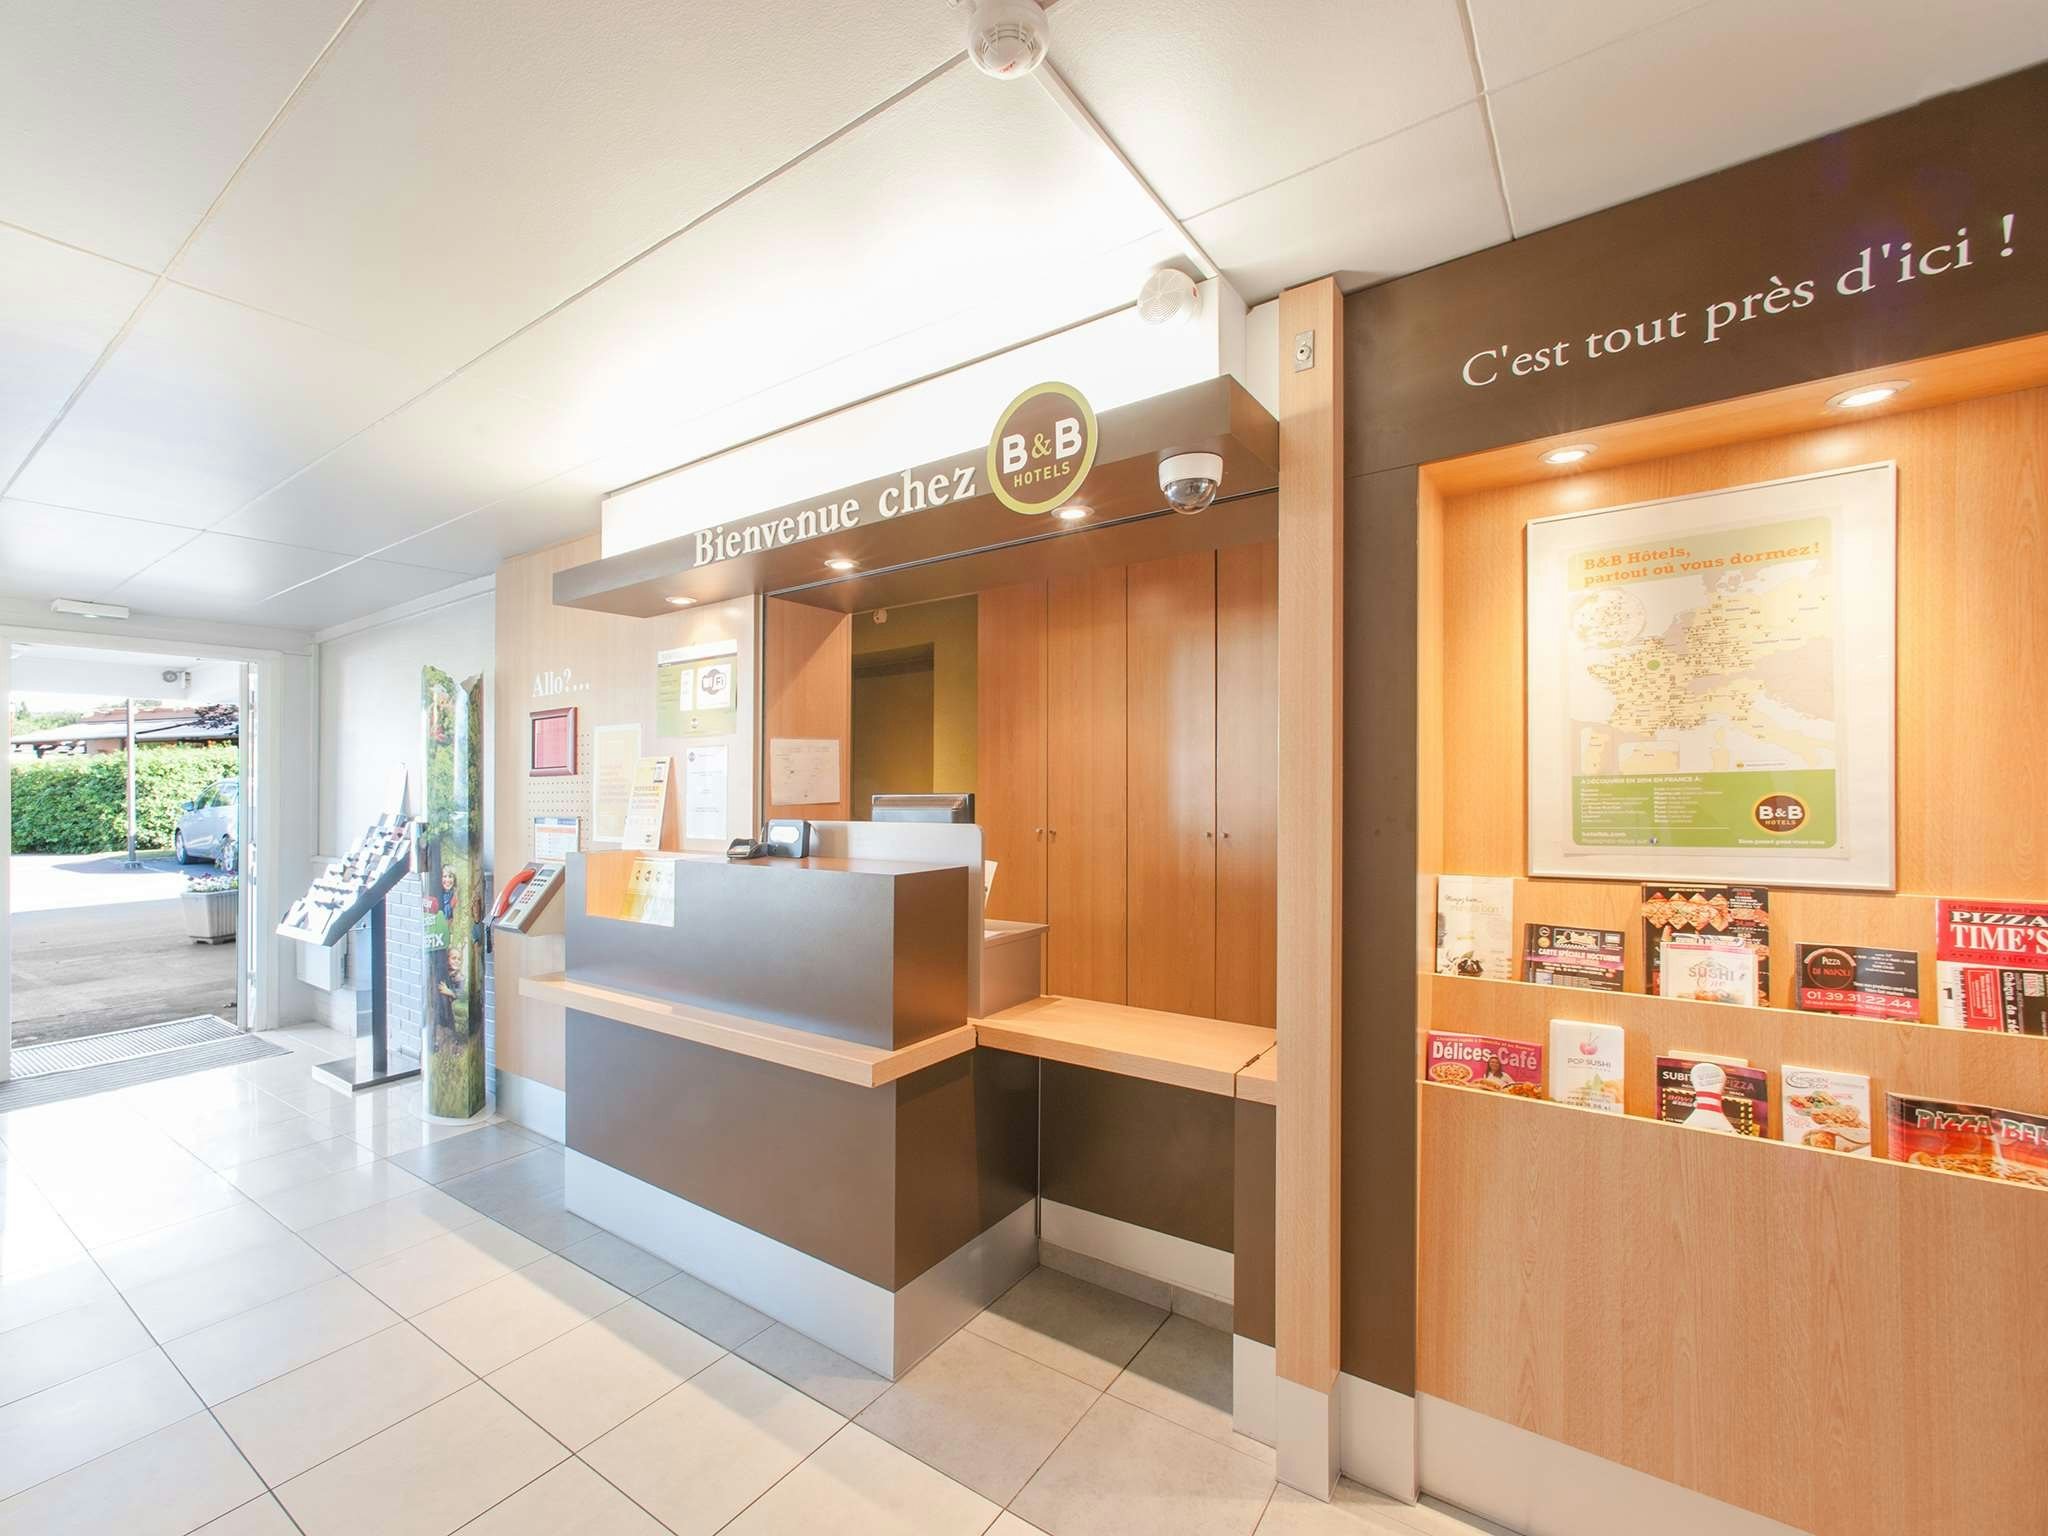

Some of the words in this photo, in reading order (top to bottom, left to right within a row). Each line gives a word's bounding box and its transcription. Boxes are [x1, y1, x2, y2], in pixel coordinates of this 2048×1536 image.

[1462, 345, 1570, 389] C'est
[1584, 310, 1687, 359] tout
[1703, 274, 1816, 344] près
[1835, 227, 1974, 297] d'ici
[1001, 416, 1083, 474] B&B
[1012, 460, 1071, 488] HOTELS
[693, 496, 860, 567] Bienvenue
[879, 466, 977, 517] chez
[1584, 554, 1622, 570] B&B
[1584, 568, 1648, 588] partout
[1679, 557, 1724, 571] vous
[1730, 545, 1810, 565] dormez
[1758, 805, 1804, 820] B&B
[1951, 911, 2048, 928] PIZZA
[1538, 948, 1557, 957] CARTE
[1688, 966, 1735, 982] SUSHI
[1585, 1059, 1612, 1069] SUSHI
[1915, 1108, 1996, 1136] PIZZA
